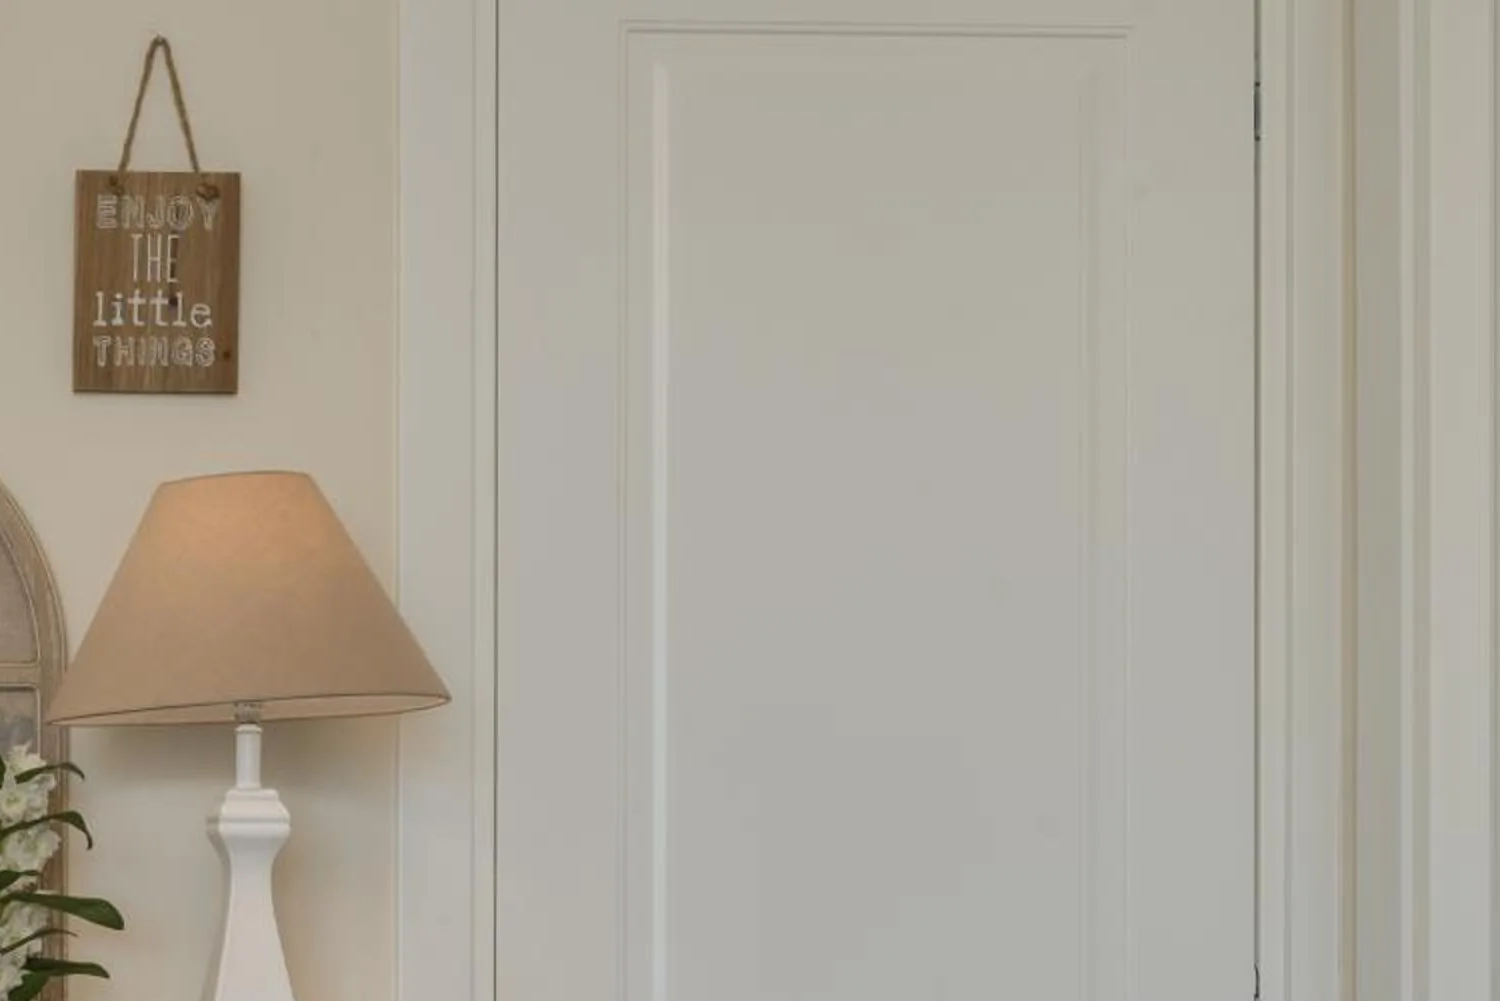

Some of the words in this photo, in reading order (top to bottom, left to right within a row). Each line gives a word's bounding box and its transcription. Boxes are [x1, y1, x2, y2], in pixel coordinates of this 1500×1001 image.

[96, 194, 219, 231] ENJOY
[131, 233, 180, 283] THE
[93, 289, 213, 328] little
[93, 336, 215, 367] THINGS
